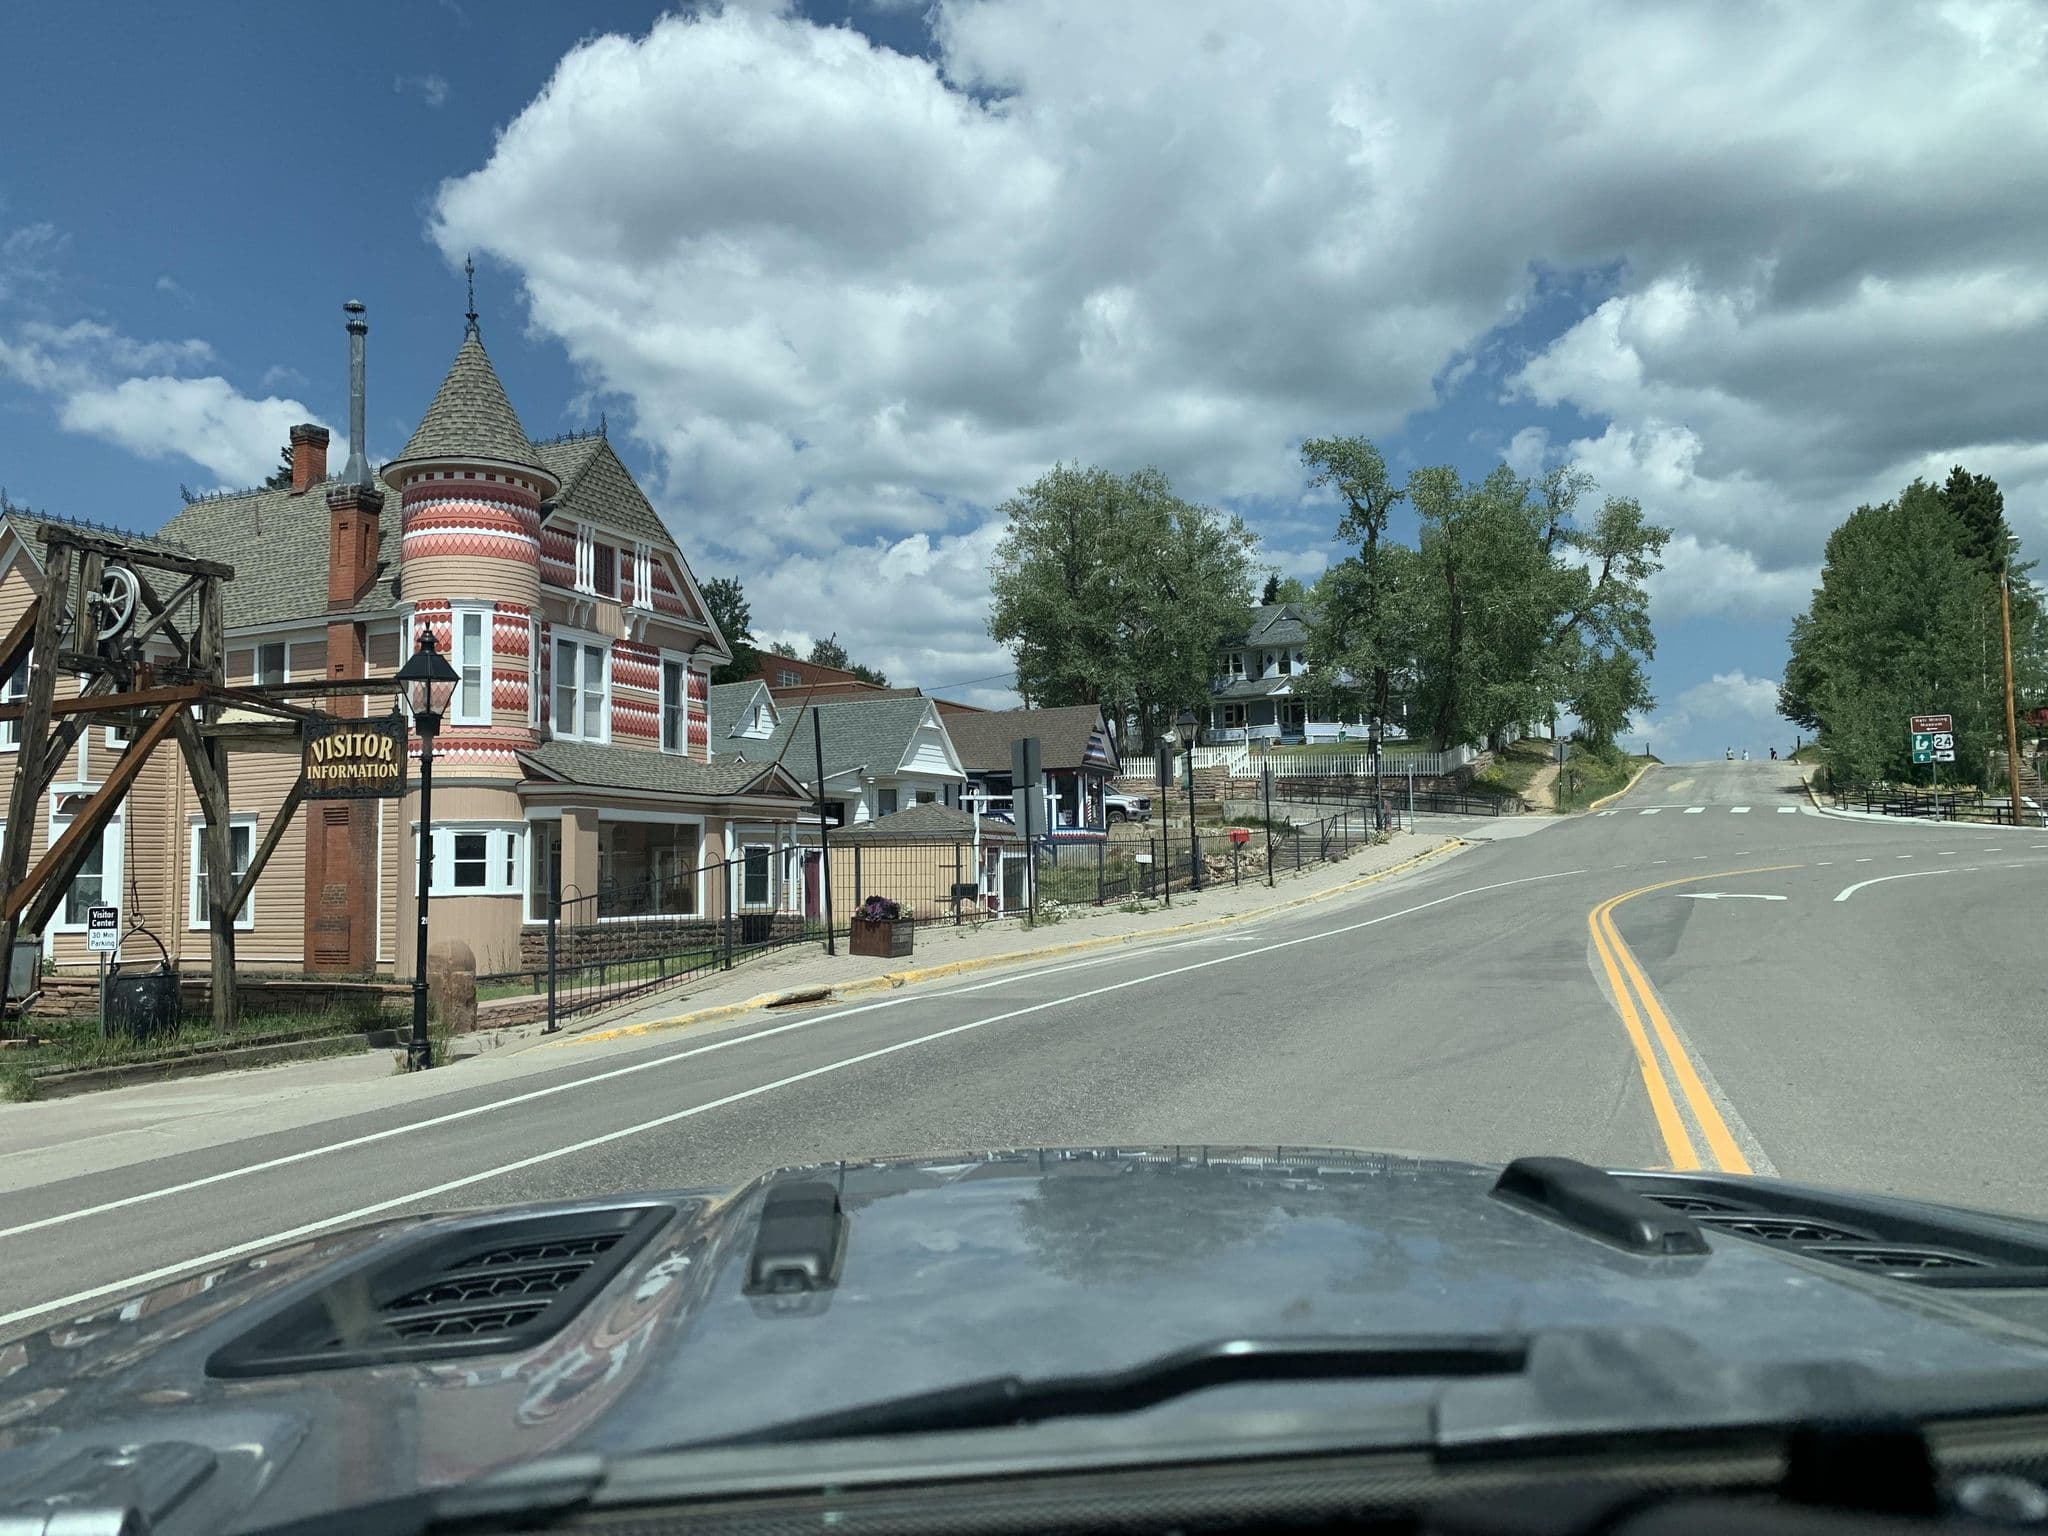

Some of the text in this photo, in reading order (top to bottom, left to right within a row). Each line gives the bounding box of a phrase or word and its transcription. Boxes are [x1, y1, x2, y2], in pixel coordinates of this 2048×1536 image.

[1935, 737, 1951, 747] 24
[311, 733, 393, 763] VISITOR
[307, 763, 398, 779] INFORMATION
[92, 909, 115, 919] Visitor
[91, 919, 115, 927] Center
[91, 940, 114, 948] Parking
